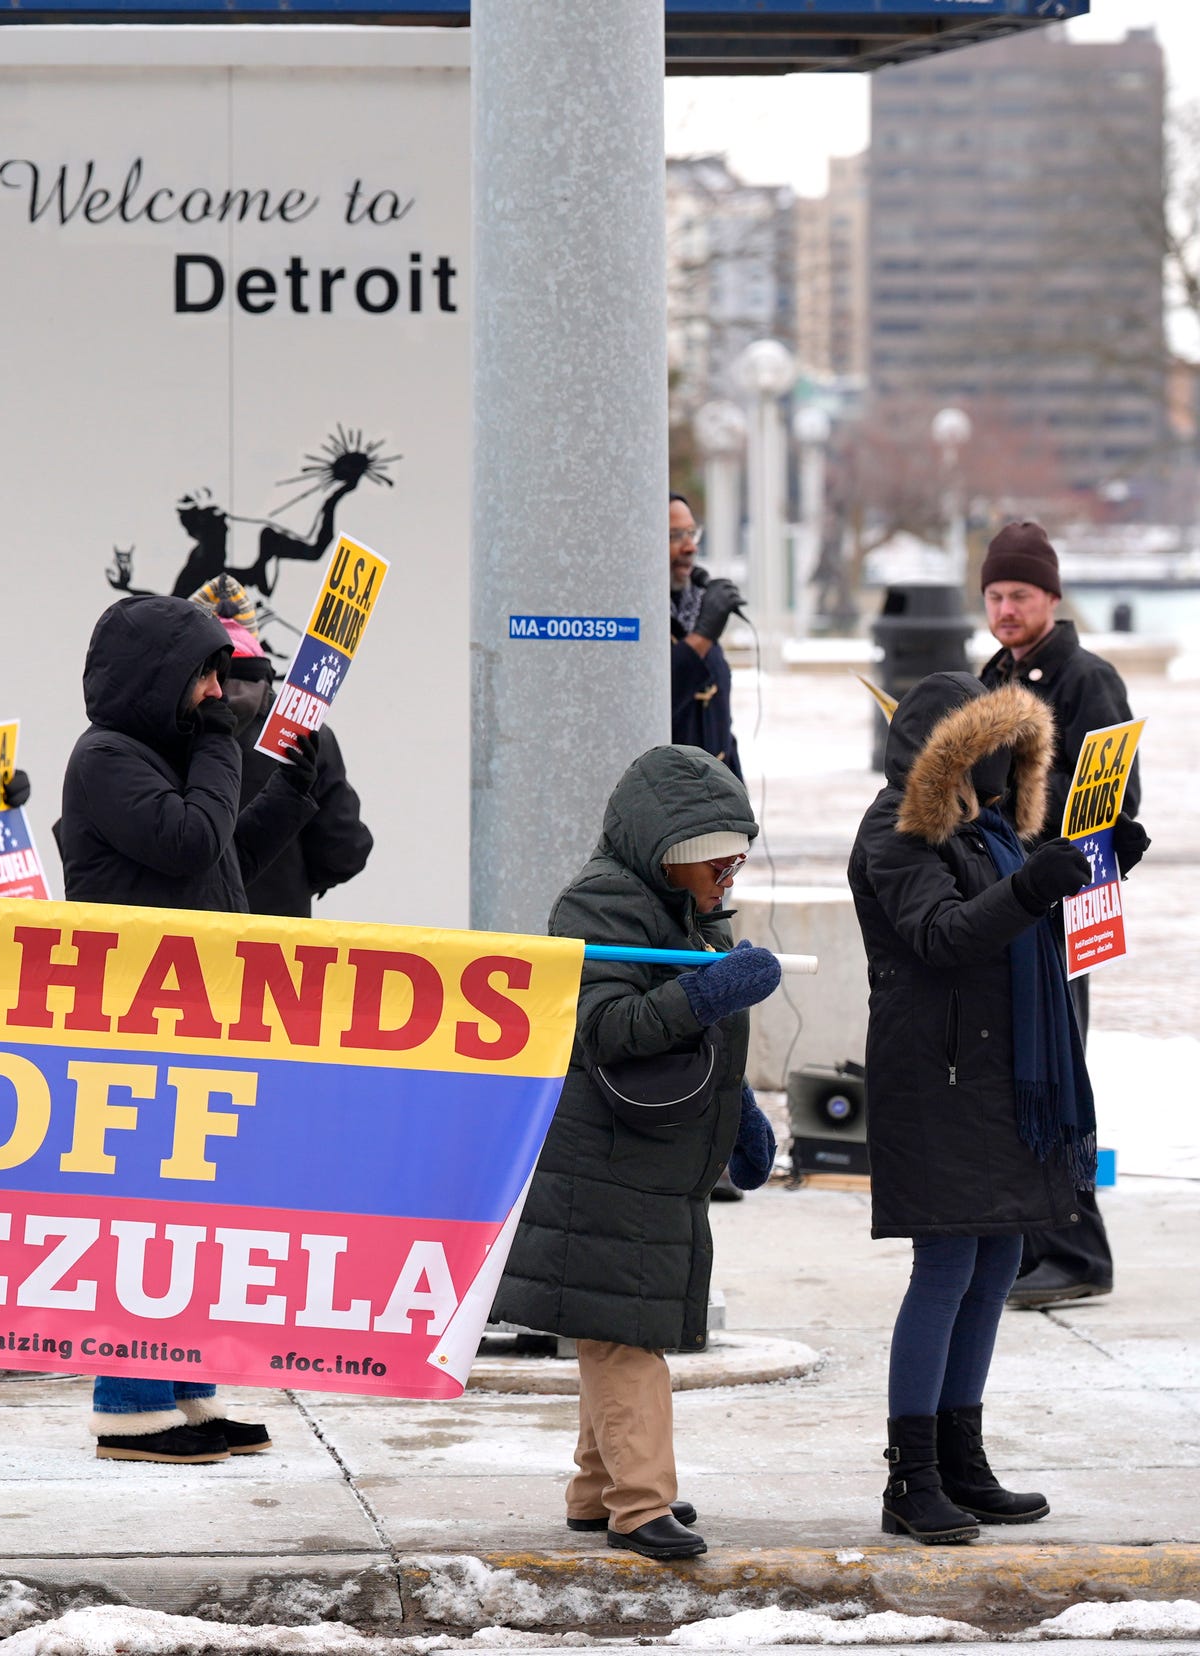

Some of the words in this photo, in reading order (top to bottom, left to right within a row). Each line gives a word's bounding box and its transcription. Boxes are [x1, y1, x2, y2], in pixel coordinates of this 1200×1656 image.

[344, 178, 415, 226] to
[174, 252, 458, 315] Detroit
[329, 546, 377, 611] U.S.A.
[313, 592, 365, 655] HANDS
[511, 618, 618, 638] MA-000359
[315, 665, 336, 698] OFF
[1076, 732, 1129, 788] U.S.A.
[1067, 778, 1120, 836] HANDS
[1064, 882, 1122, 935] VENEZUELA
[6, 926, 533, 1061] HANDS
[80, 1337, 202, 1363] Coalition
[269, 1352, 387, 1377] afoc.info
